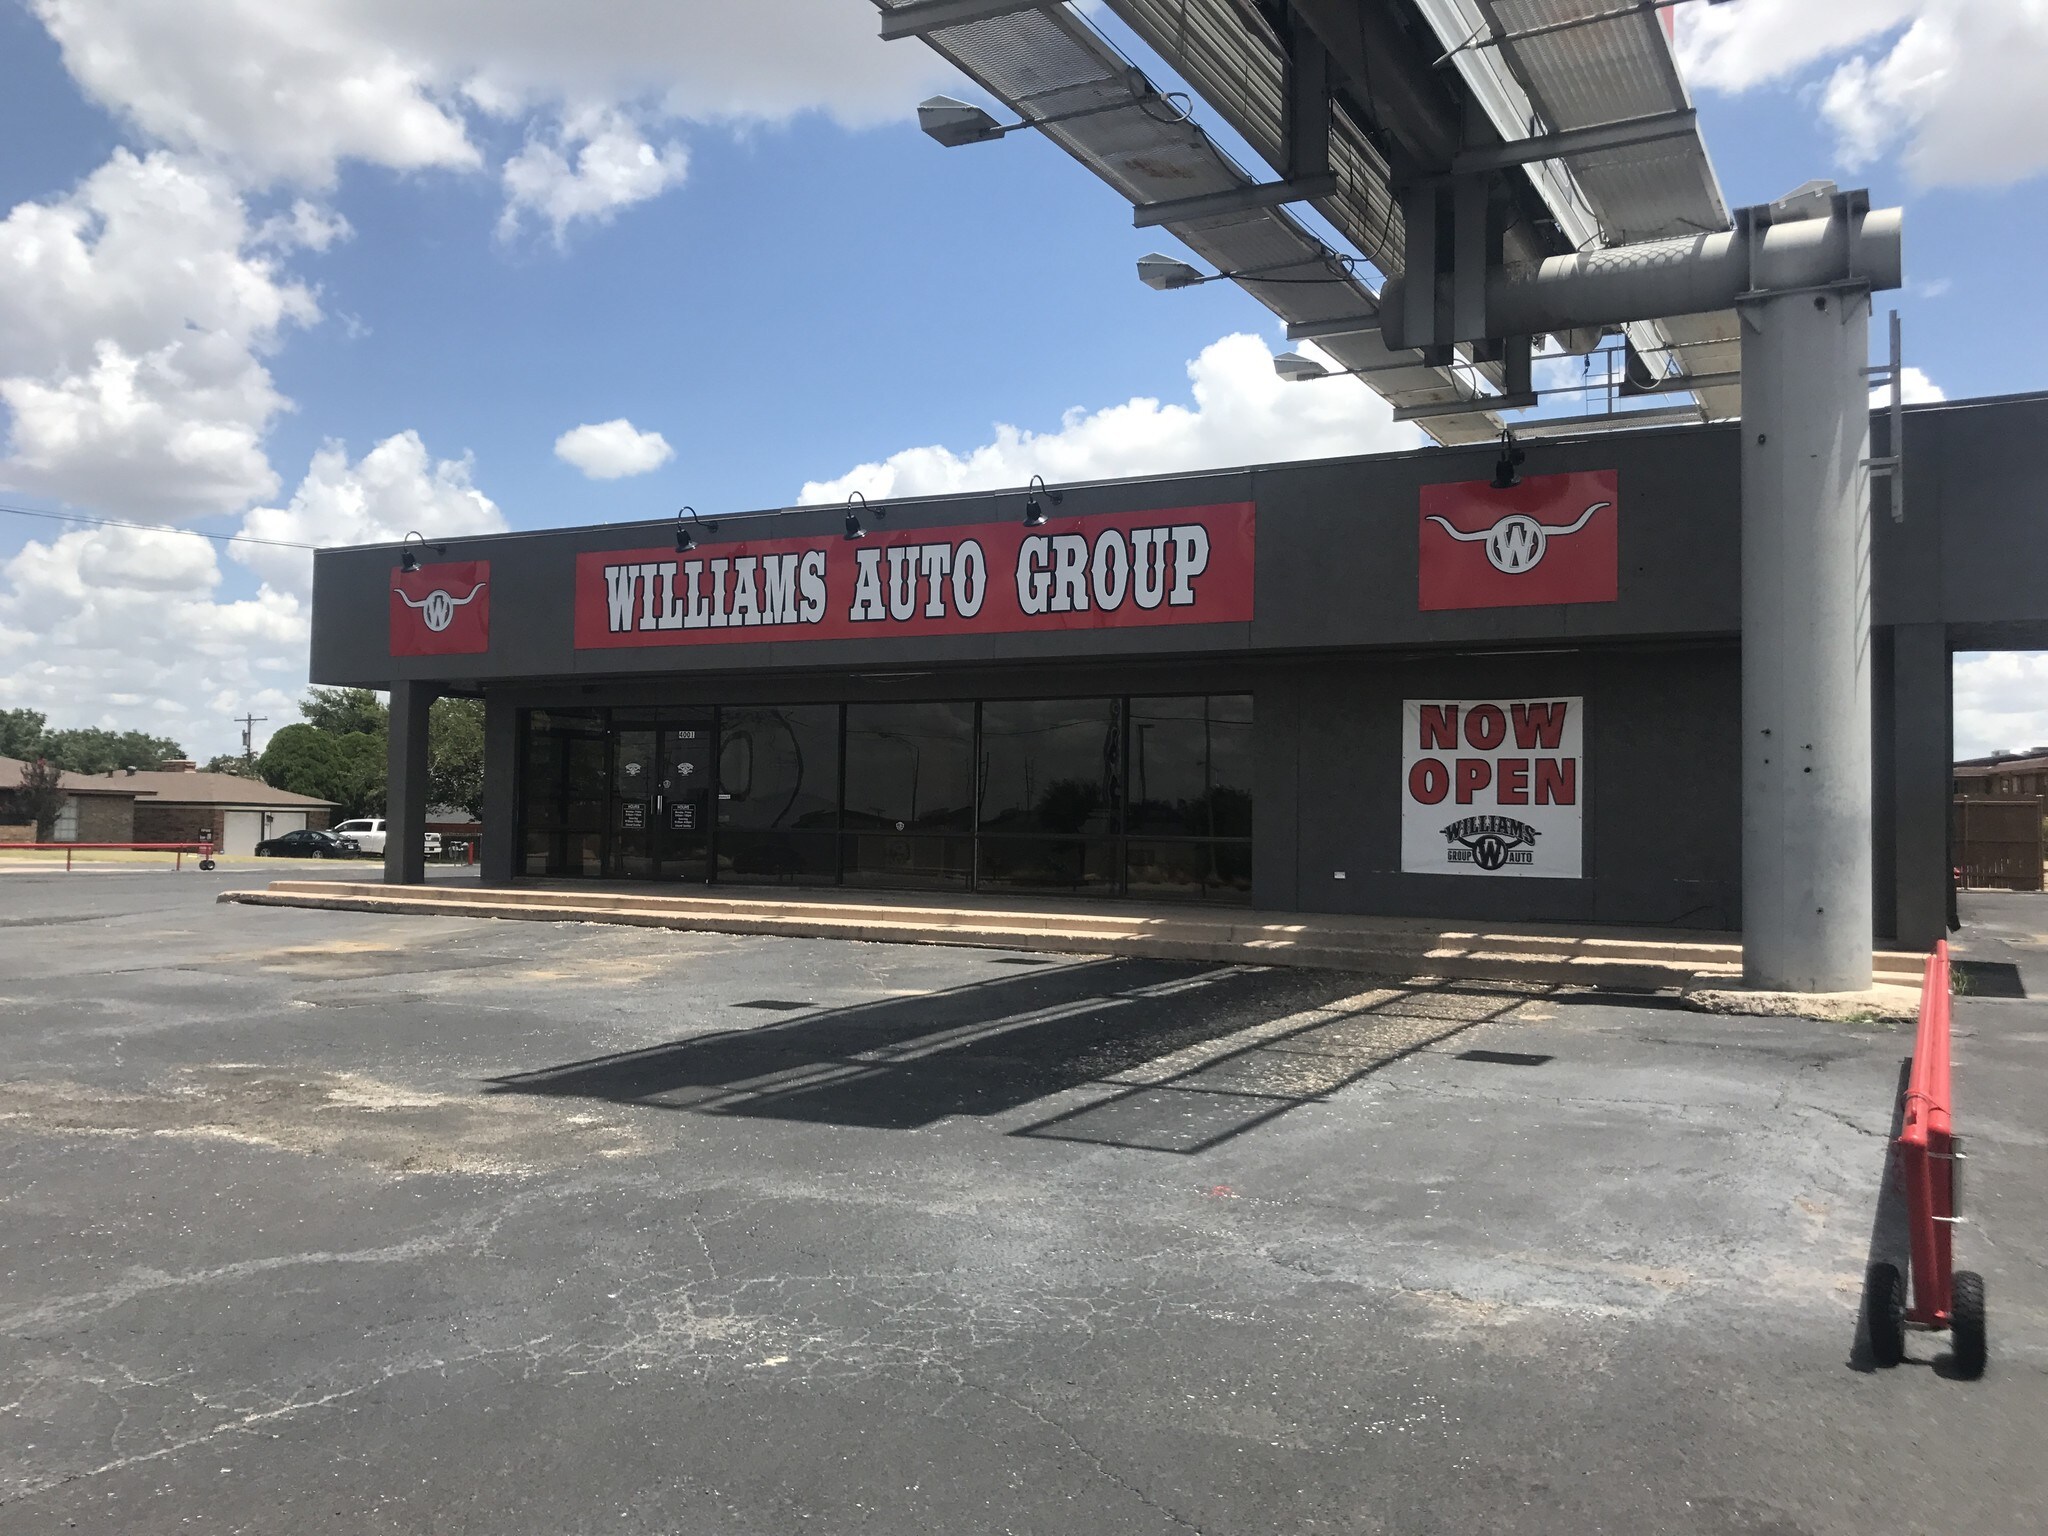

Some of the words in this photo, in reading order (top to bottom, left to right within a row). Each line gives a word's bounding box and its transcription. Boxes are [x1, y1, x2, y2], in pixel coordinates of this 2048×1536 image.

[603, 549, 828, 634] WILLIAMS
[848, 538, 989, 623] AUTO
[1013, 522, 1212, 618] GROUP
[678, 731, 695, 739] 4001
[1420, 702, 1568, 750] NOW
[1408, 757, 1577, 806] OPEN
[1443, 814, 1538, 847] WILLIAMS
[1446, 849, 1472, 862] GROUP
[1508, 851, 1533, 863] AUTO
